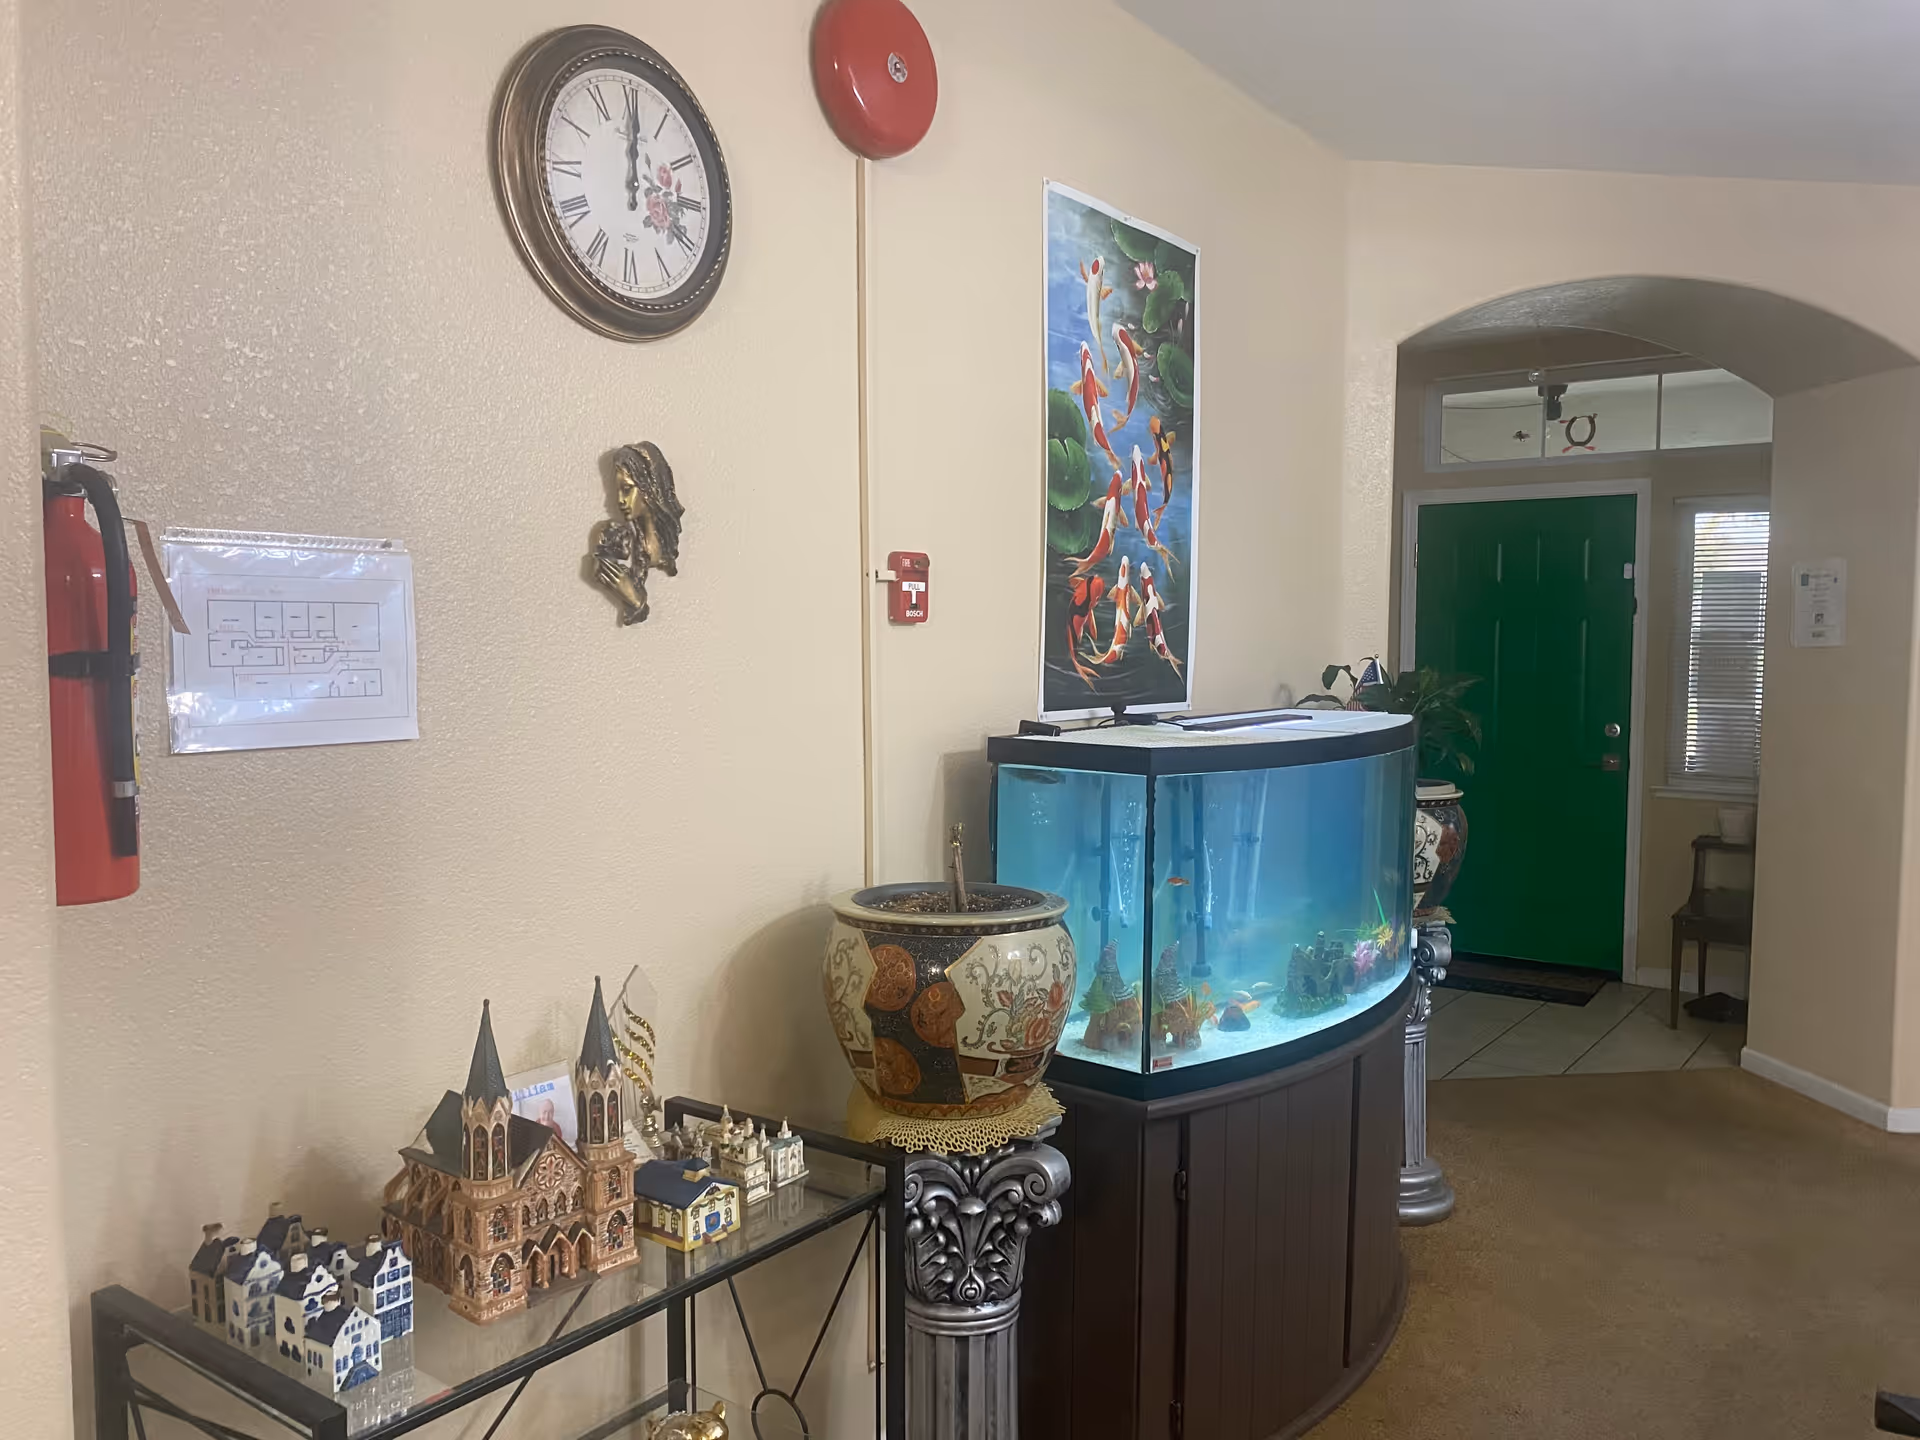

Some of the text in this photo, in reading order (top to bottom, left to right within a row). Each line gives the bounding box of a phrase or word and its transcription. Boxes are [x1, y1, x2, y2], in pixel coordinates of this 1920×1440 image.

[586, 84, 612, 125] XI
[560, 109, 591, 147] X
[670, 153, 693, 172] II
[559, 193, 591, 229] VIII
[677, 194, 701, 213] III
[586, 226, 609, 269] VII
[653, 246, 671, 283] V
[623, 247, 639, 285] VI
[908, 582, 920, 590] PULL
[905, 610, 924, 618] BOSCH
